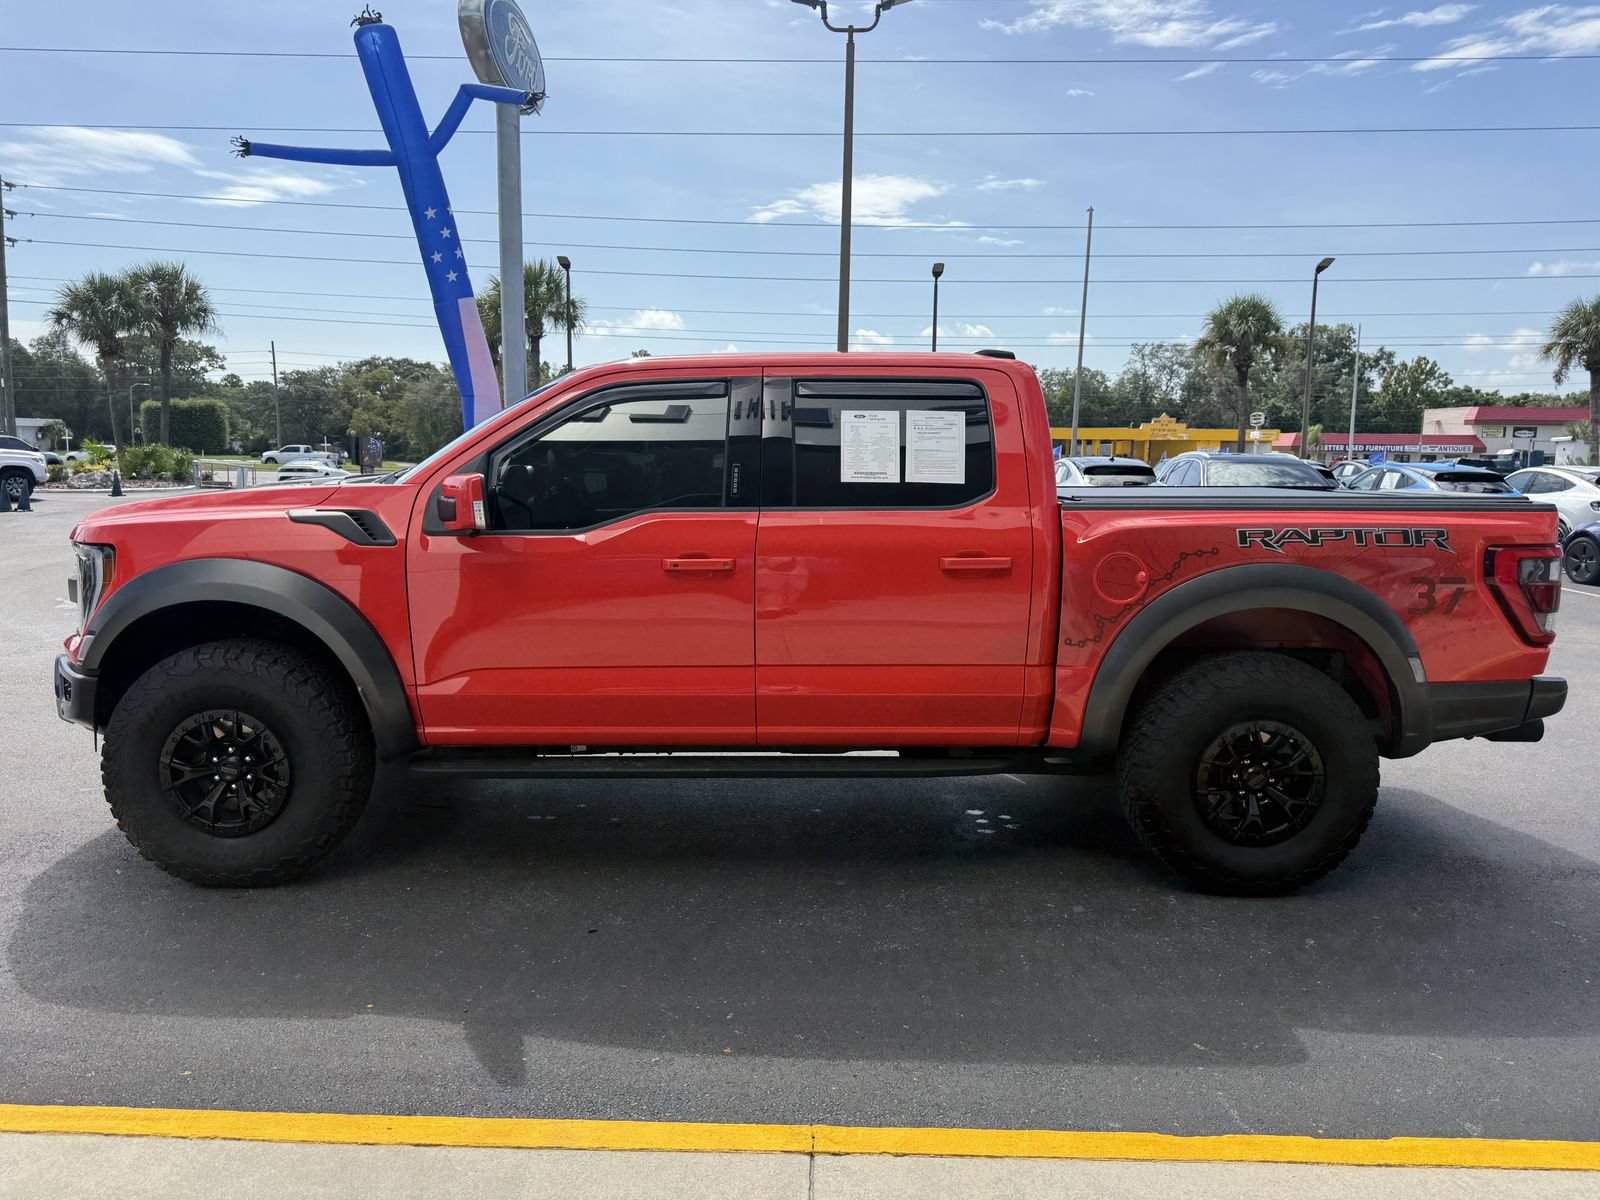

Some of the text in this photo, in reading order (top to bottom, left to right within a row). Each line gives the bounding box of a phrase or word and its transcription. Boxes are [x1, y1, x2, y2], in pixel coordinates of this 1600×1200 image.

[504, 12, 539, 91] Ford
[1236, 527, 1456, 555] RAPTOR
[1408, 576, 1466, 616] 37
